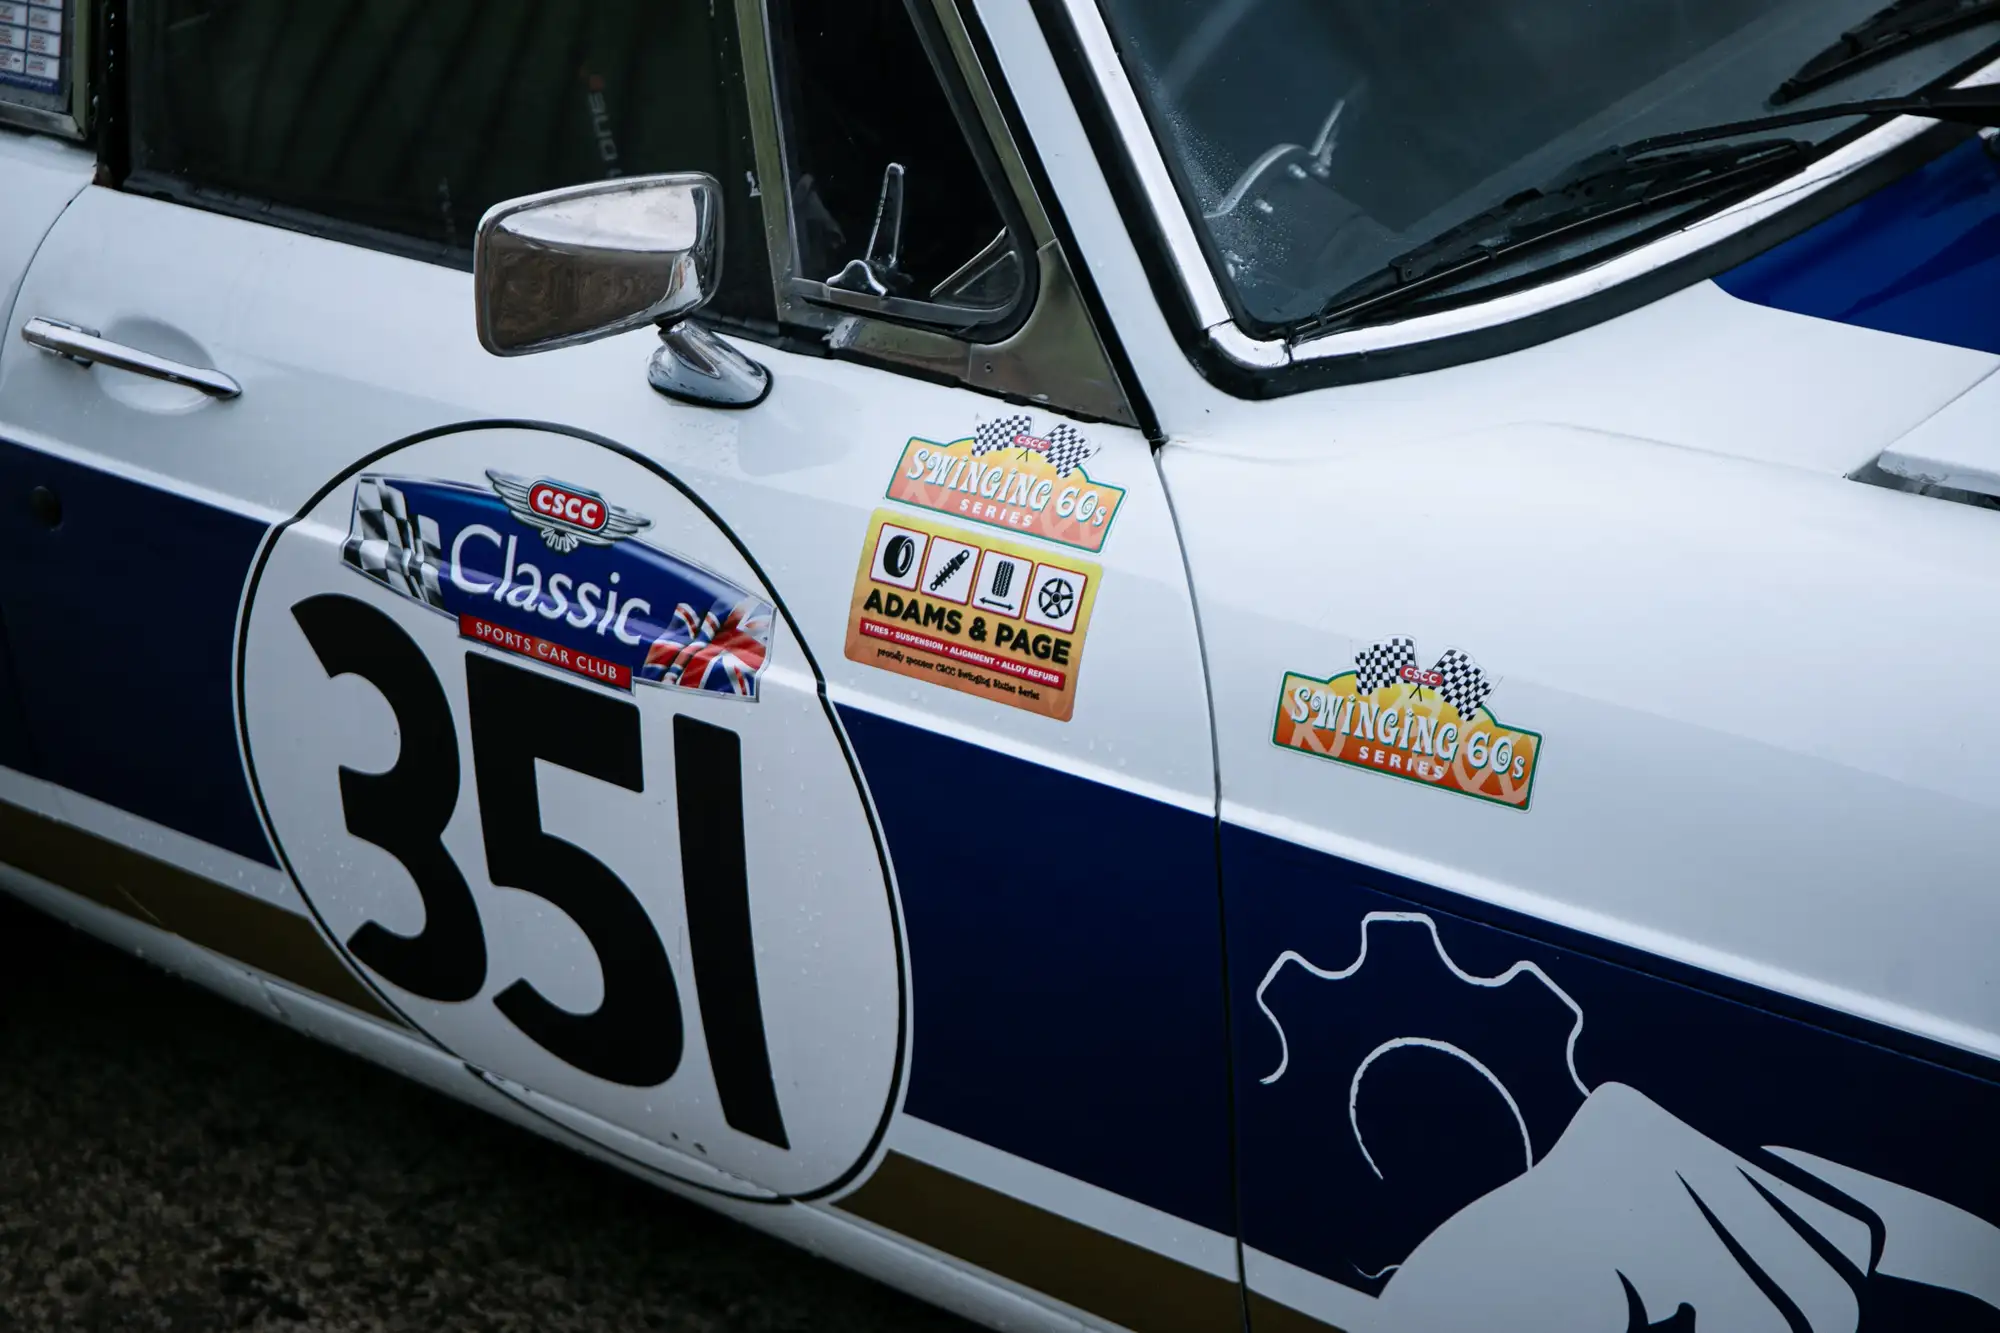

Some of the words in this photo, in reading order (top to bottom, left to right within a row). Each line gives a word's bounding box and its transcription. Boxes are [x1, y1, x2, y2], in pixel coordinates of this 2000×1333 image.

[1017, 435, 1048, 449] CSCC
[536, 489, 598, 524] CSCC
[906, 447, 1053, 512] SWINGING
[1056, 485, 1107, 527] 60s
[959, 498, 1033, 528] SERIES
[450, 523, 651, 646] Classic
[475, 621, 532, 657] SPORTS
[538, 641, 570, 664] CAR
[576, 654, 617, 680] CLUB
[863, 588, 963, 635] ADAMS
[968, 616, 988, 643] &
[994, 622, 1071, 665] PAGE
[864, 622, 889, 636] TYRES
[895, 631, 944, 651] SUSPENSION
[949, 646, 996, 665] ALIGNMENT
[1001, 660, 1027, 674] ALLOY
[1027, 668, 1060, 683] REFURB
[1403, 665, 1439, 684] CSCC
[1291, 686, 1459, 763] SWINGING
[1467, 730, 1526, 780] 60s
[1358, 745, 1445, 779] SERIES
[290, 592, 790, 1150] 351
